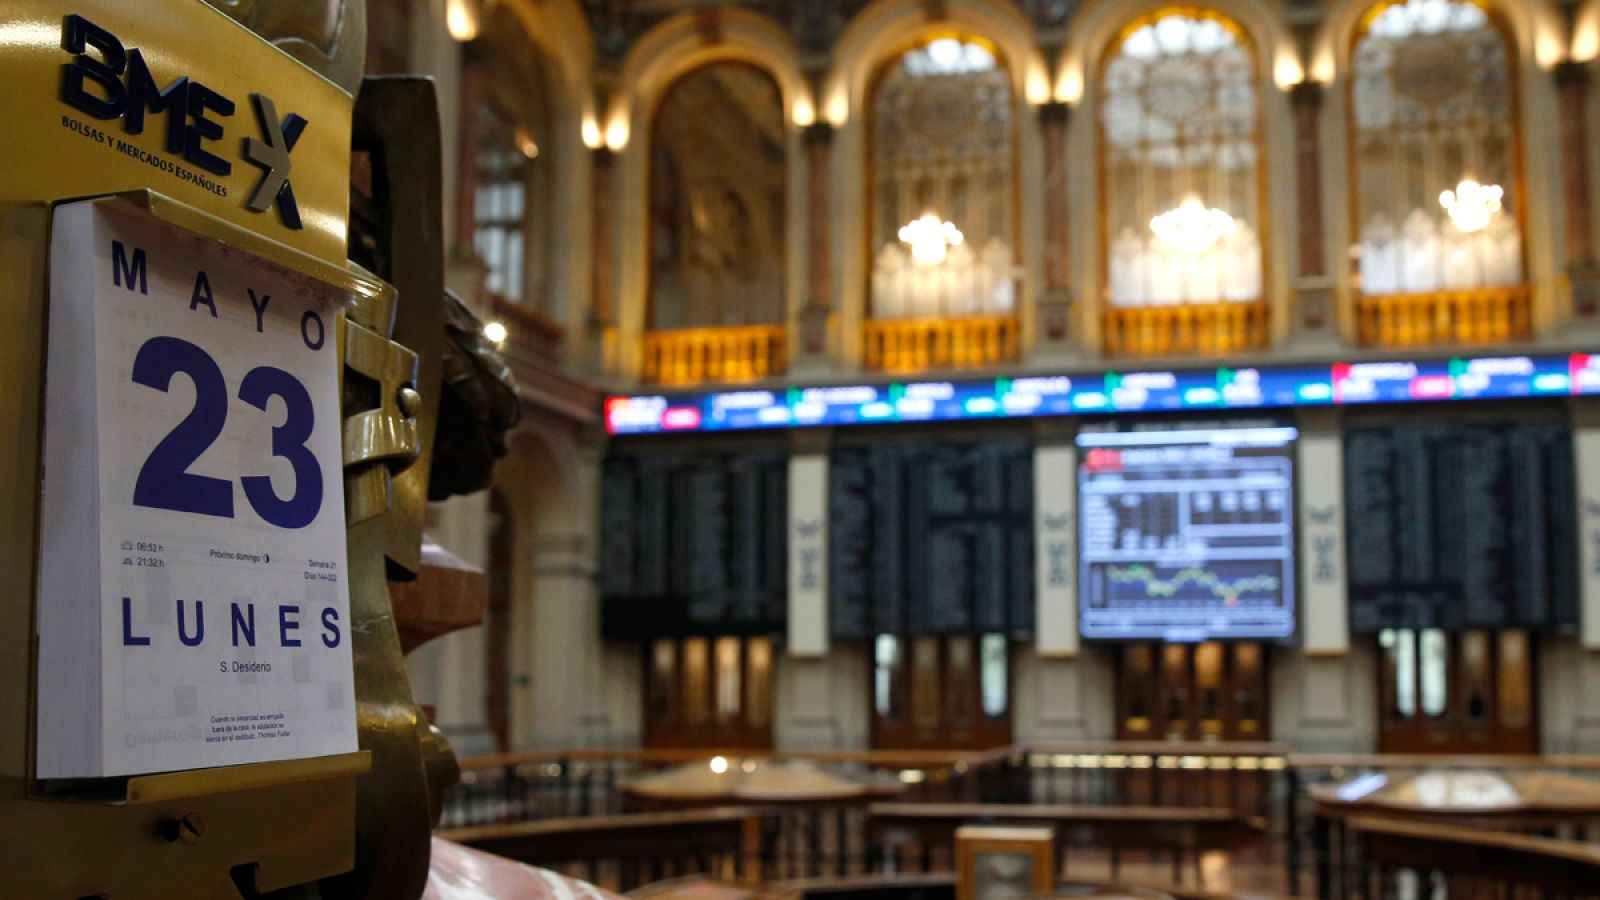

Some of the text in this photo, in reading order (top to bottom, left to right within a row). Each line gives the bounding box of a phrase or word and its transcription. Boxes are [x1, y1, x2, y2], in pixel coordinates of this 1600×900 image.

[61, 115, 228, 198] BOLSAS Y MERCADOS ESPAÑOLES
[112, 239, 325, 351] MAYO
[131, 336, 324, 529] 23
[122, 597, 341, 649] LUNES
[220, 661, 272, 673] S. Desiderio
